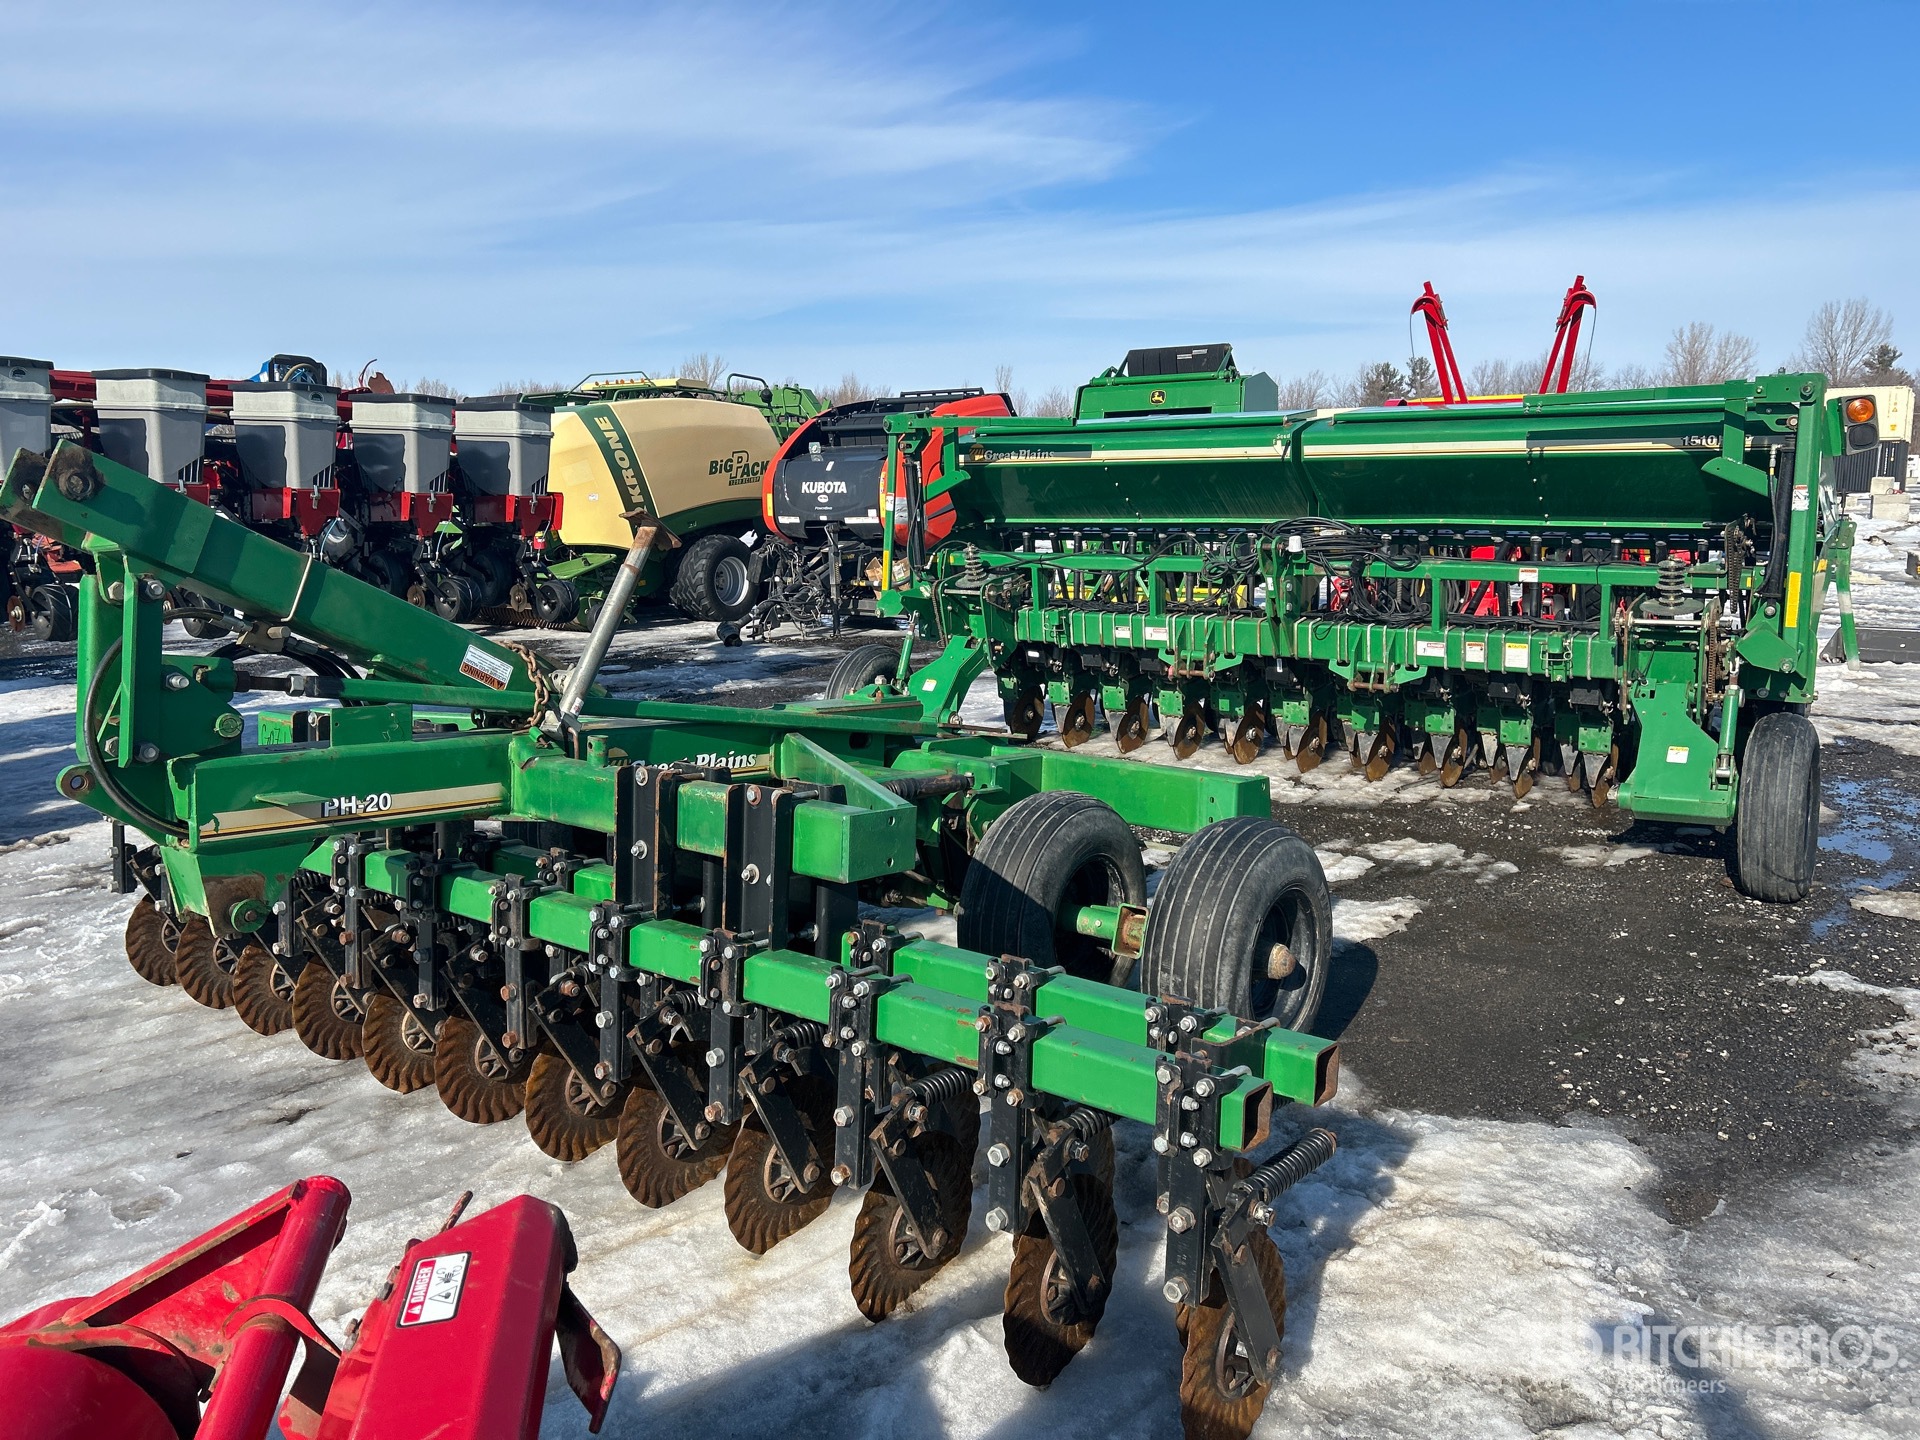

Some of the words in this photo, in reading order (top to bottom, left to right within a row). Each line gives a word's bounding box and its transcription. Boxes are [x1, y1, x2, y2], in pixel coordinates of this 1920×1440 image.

[594, 416, 644, 503] KRONE
[984, 450, 1018, 460] Great
[1019, 448, 1055, 459] Plains
[801, 481, 847, 494] KUBOTA
[463, 664, 496, 685] WARNING
[695, 750, 757, 769] Plains
[321, 792, 393, 818] PH-20
[410, 1266, 434, 1304] DANGER
